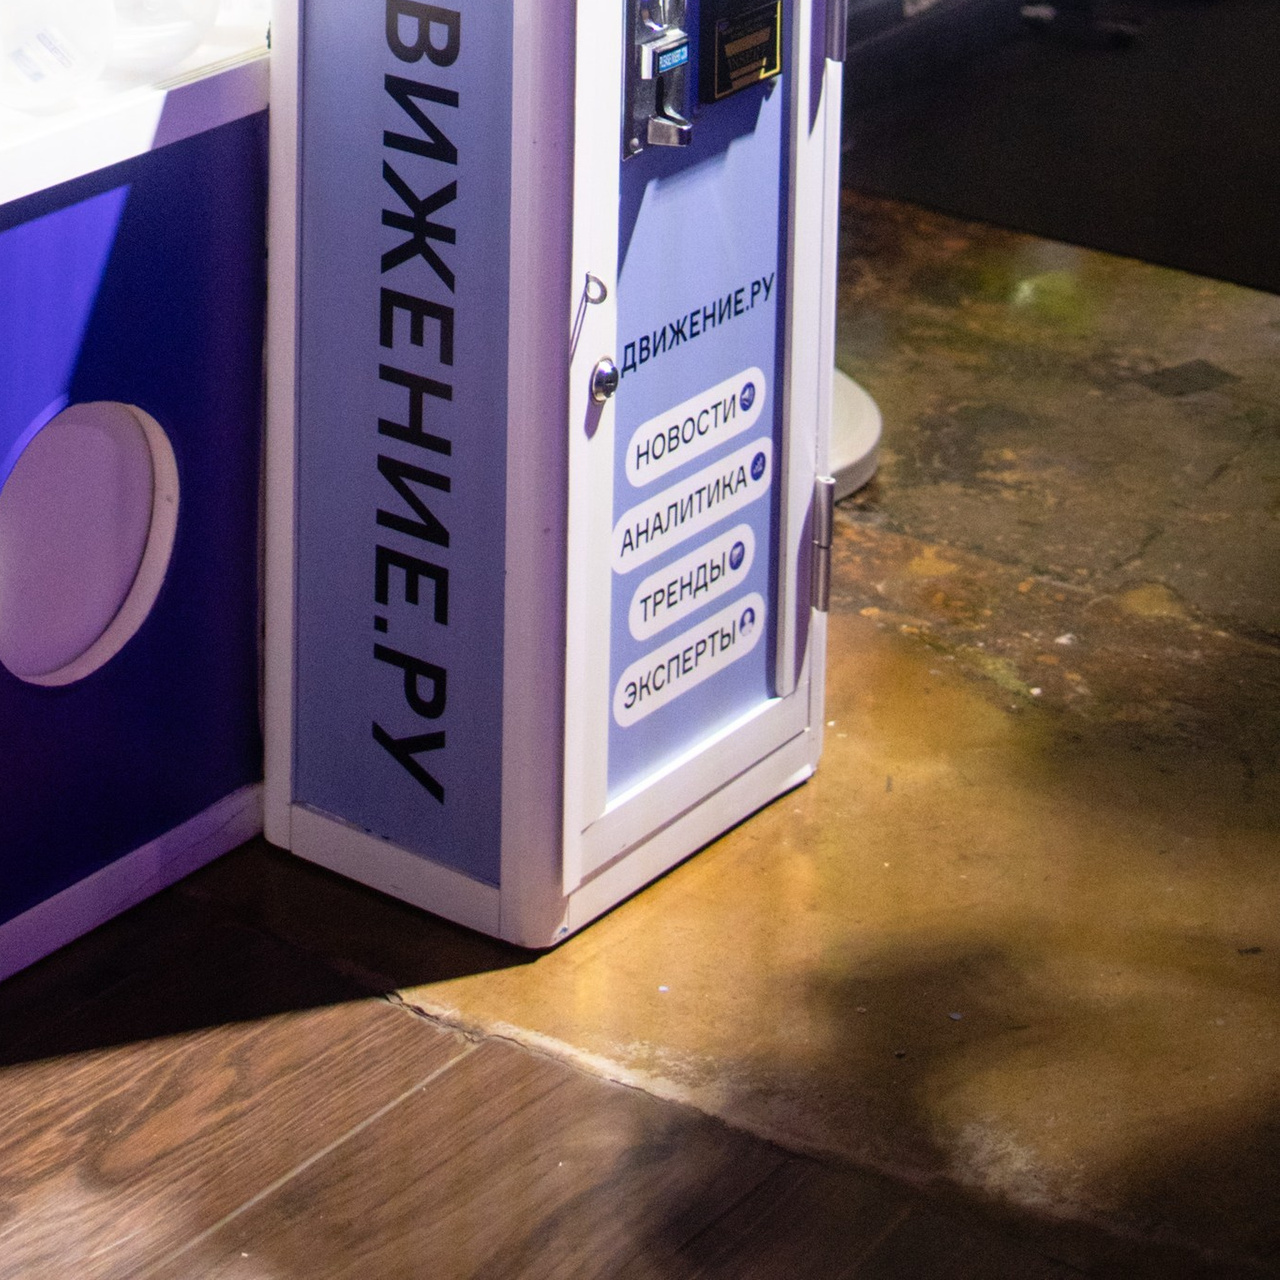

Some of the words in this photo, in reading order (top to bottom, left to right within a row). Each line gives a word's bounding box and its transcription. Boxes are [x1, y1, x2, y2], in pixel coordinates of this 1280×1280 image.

[621, 272, 775, 378] ДВИЖЕНИЕ.РУ
[635, 392, 737, 470] НОВОСТИ
[620, 464, 748, 557] АНАЛИТИКА
[639, 551, 726, 624] ТРЕНДЫ
[623, 620, 736, 709] ЭКСПЕРТЫ
